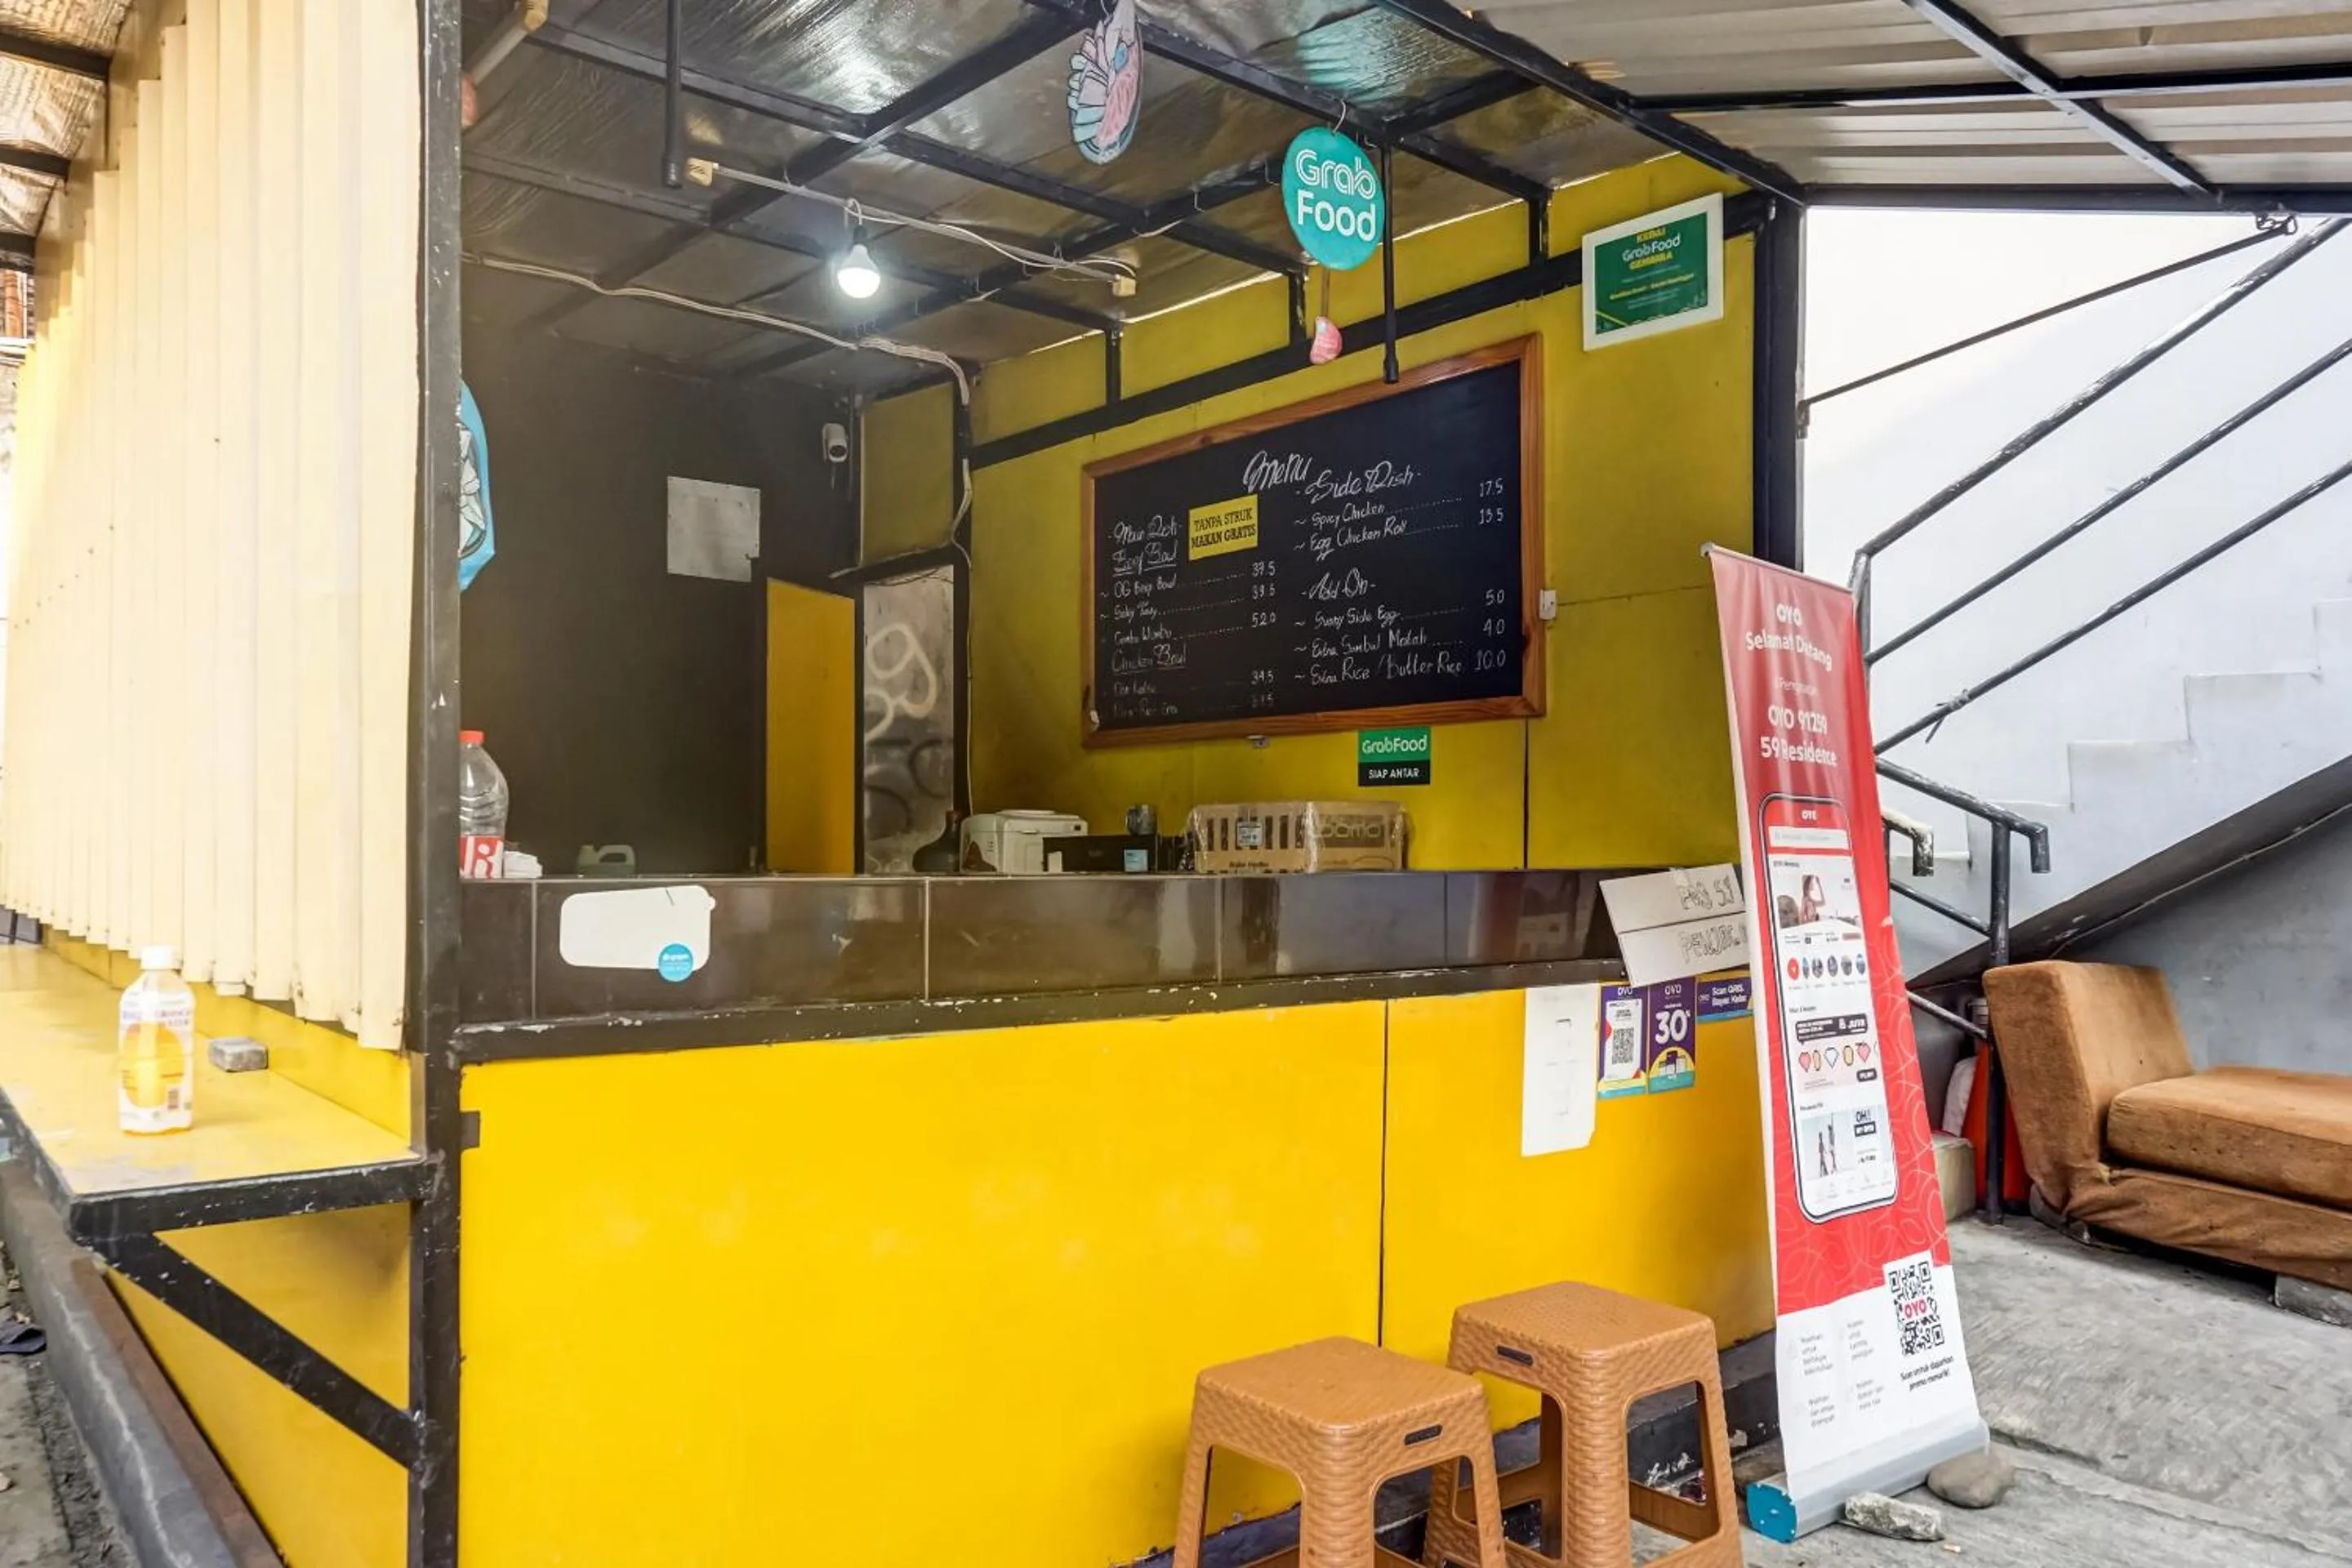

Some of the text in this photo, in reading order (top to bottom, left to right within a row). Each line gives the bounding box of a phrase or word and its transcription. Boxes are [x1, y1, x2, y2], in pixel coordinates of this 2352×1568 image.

[1295, 149, 1377, 200] Grab
[1297, 189, 1376, 242] Food
[1193, 507, 1254, 532] TANPA STRUK
[1342, 501, 1386, 523] Chicken
[1191, 531, 1223, 550] MAKAN
[1336, 527, 1382, 548] Chicken
[1775, 603, 1802, 625] OYO
[1744, 628, 1795, 652] Selamat
[1767, 704, 1795, 730] OYO
[1361, 734, 1428, 755] GrabFood
[1759, 735, 1780, 759] 59
[1368, 767, 1420, 779] SIAP ANTAR
[1904, 1299, 1927, 1320] OYO
